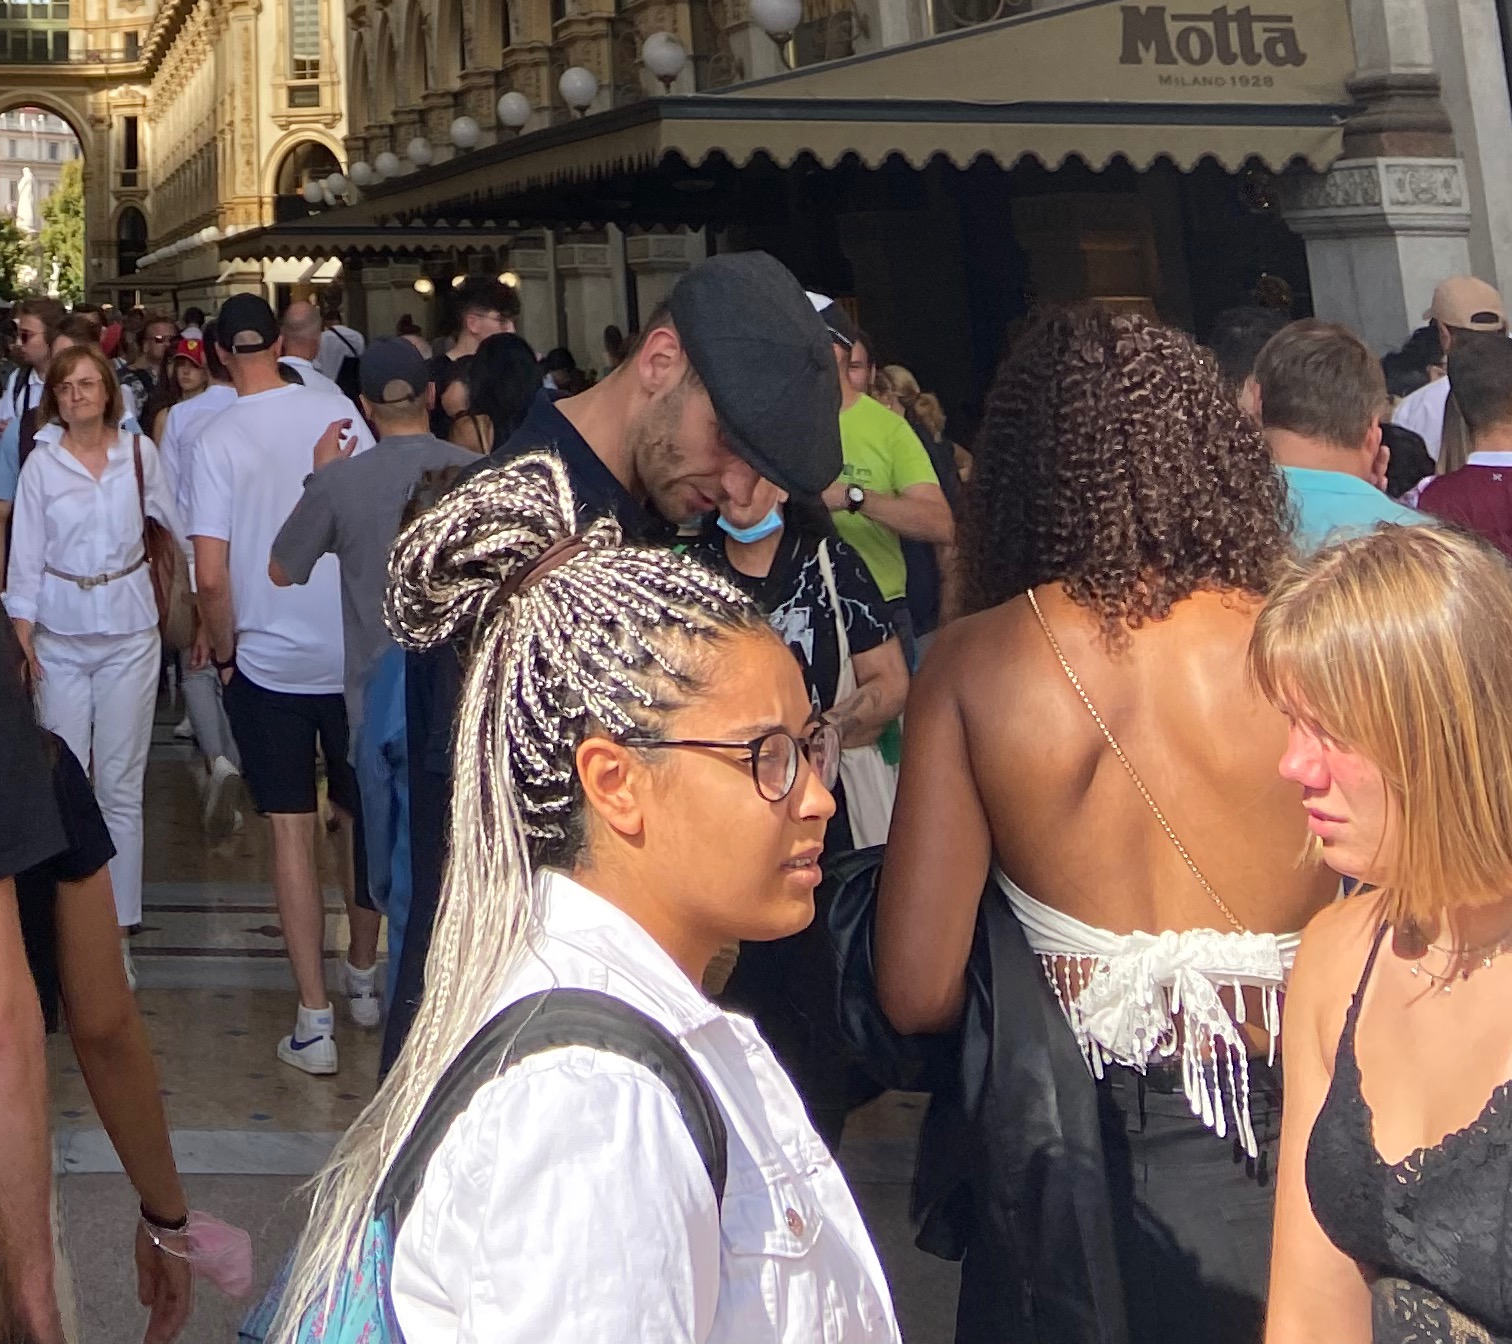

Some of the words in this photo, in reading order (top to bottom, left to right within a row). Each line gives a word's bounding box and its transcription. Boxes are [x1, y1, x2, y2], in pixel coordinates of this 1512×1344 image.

[1119, 4, 1308, 67] Motta
[1157, 74, 1227, 89] MILANO
[1230, 74, 1274, 88] 1928
